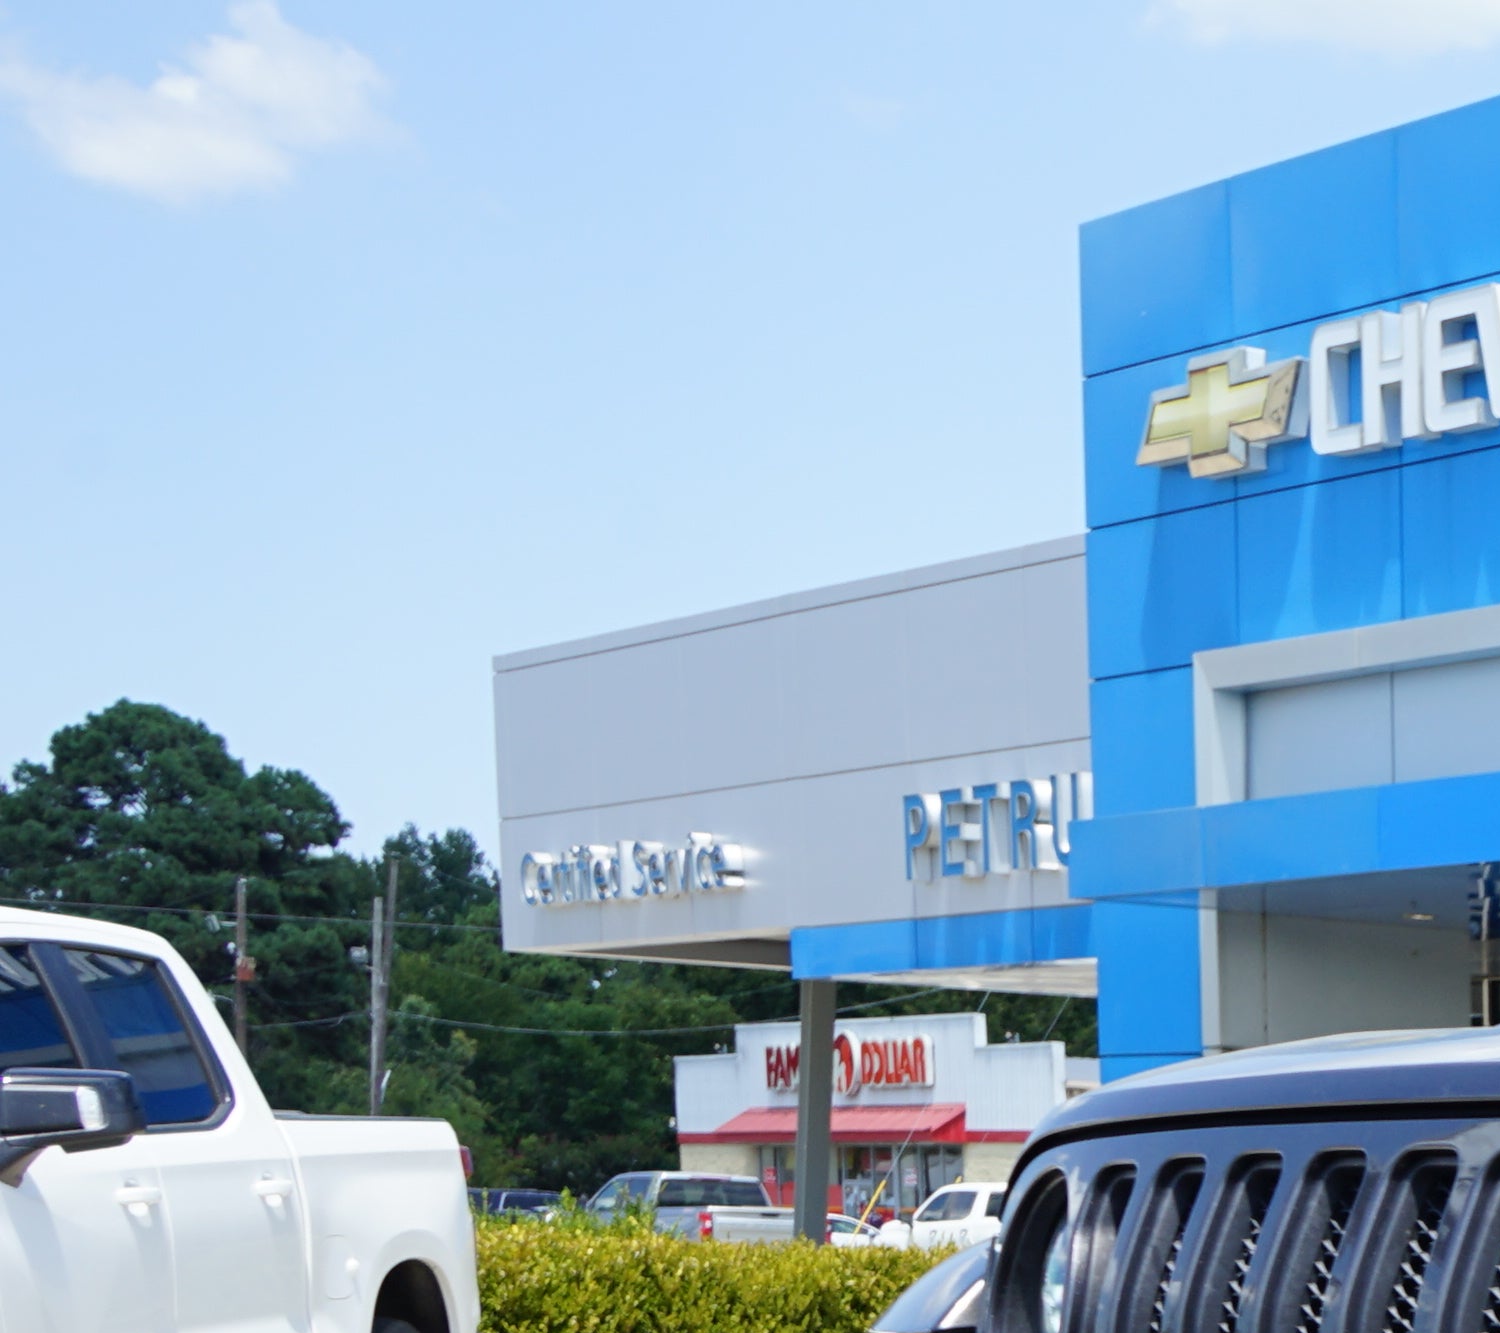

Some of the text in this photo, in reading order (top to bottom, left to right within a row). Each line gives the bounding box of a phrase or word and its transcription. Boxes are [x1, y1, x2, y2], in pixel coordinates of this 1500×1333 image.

[903, 770, 1094, 880] PETRU
[520, 831, 745, 906] Certified Service
[766, 1036, 932, 1091] FAM DOLLAR
